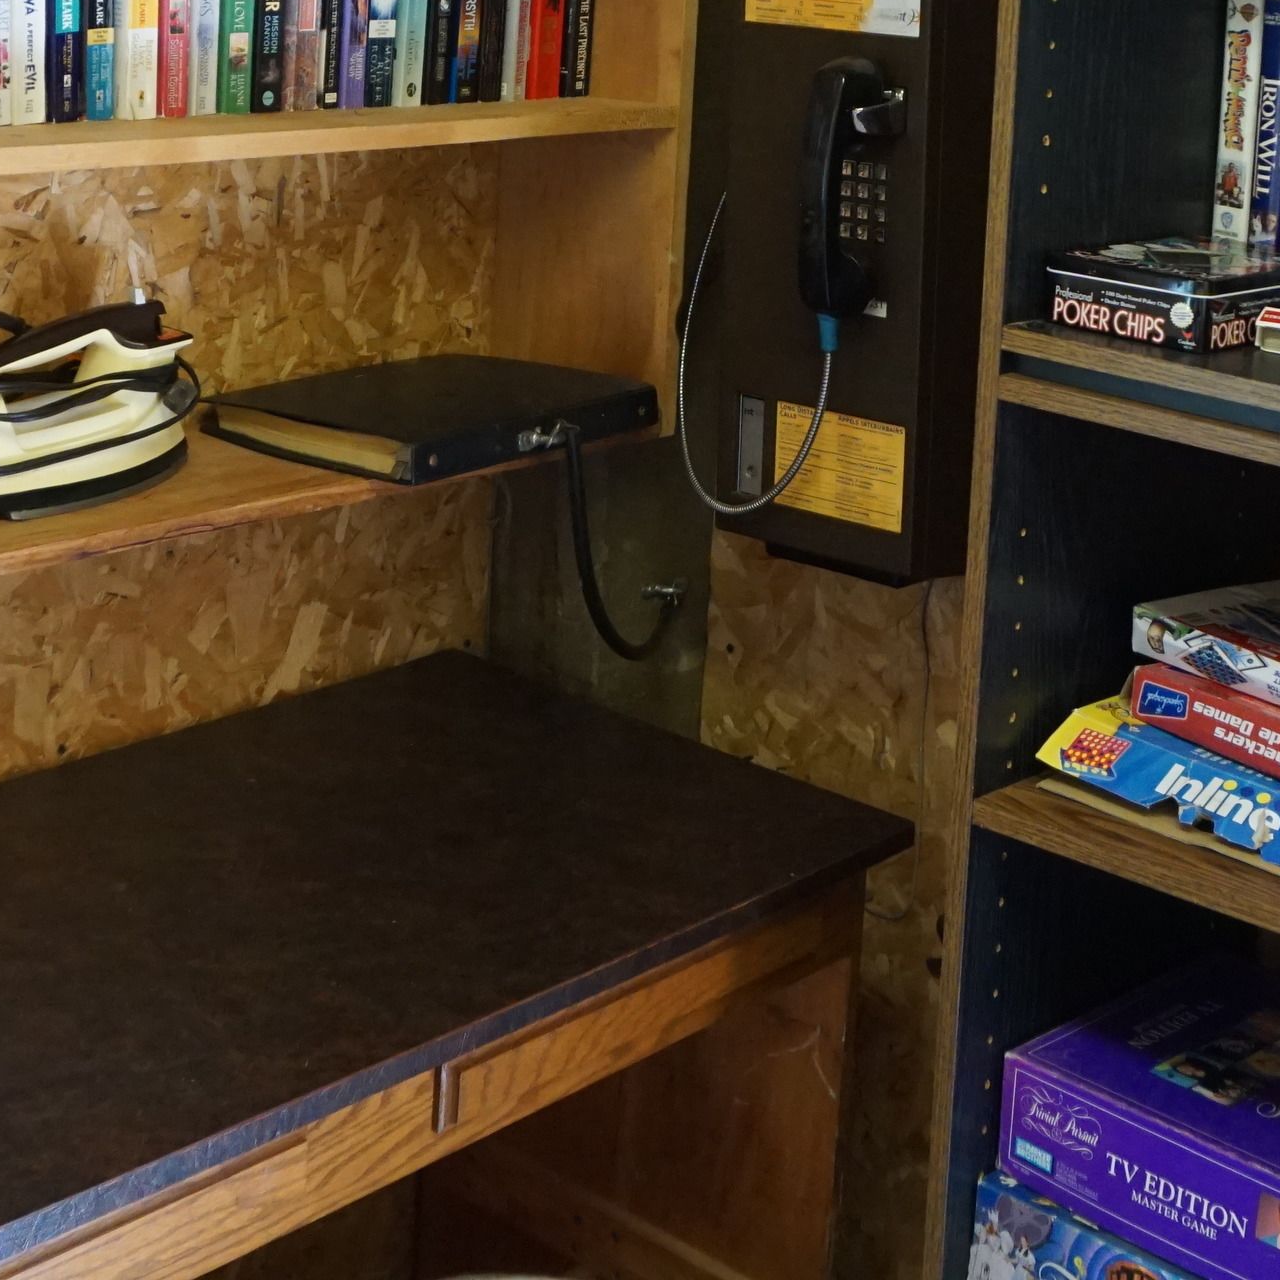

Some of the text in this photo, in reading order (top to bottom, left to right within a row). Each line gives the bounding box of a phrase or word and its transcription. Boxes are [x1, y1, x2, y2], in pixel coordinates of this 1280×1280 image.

[233, 1, 245, 31] LOVE
[262, 15, 279, 54] MISSION CANYON
[578, 15, 590, 37] LAST
[576, 38, 588, 80] PRECINCT
[1253, 133, 1277, 198] WILL
[1055, 285, 1094, 302] Professional
[1053, 297, 1110, 332] POKER
[1113, 310, 1166, 344] CHIPS
[1210, 320, 1246, 350] POKER
[1192, 701, 1256, 735] Dames
[1106, 1152, 1141, 1185] TV
[1144, 1172, 1249, 1240] EDITION
[1131, 1190, 1219, 1241] MASTER GAME
